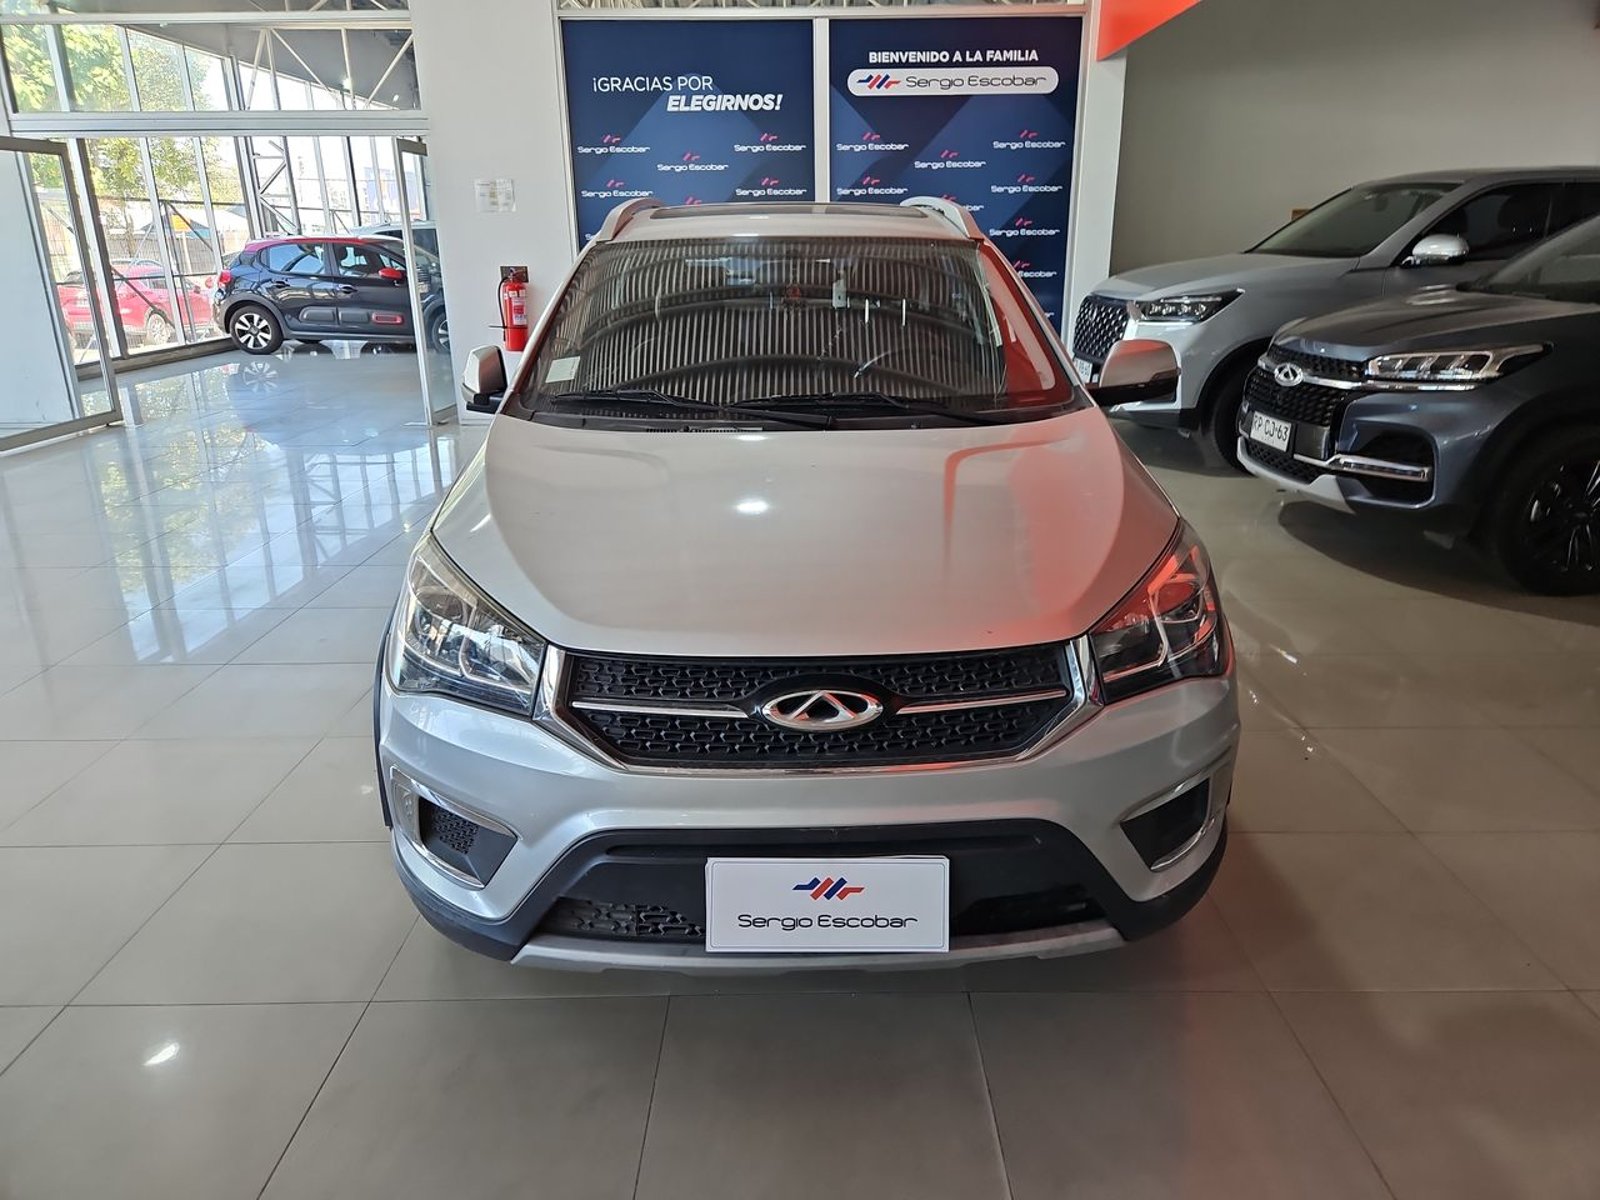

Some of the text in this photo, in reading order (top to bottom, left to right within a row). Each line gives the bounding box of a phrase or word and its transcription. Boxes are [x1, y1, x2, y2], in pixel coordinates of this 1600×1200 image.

[869, 49, 1039, 64] BIENVENIDO A LA FAMILIA
[593, 75, 713, 93] ¡GRACIAS POR
[905, 75, 1047, 90] Sergio Escobar
[666, 94, 783, 112] ELEGIRNOS!
[868, 143, 909, 151] Escobar
[1025, 140, 1066, 148] Escobar
[689, 163, 729, 171] Escobar
[946, 160, 986, 168] Escobar
[767, 188, 807, 196] Escobar
[868, 187, 908, 195] Escobar
[1023, 184, 1063, 192] Escobar
[1020, 228, 1060, 236] Escobar
[737, 914, 918, 931] Sergio Escobar
